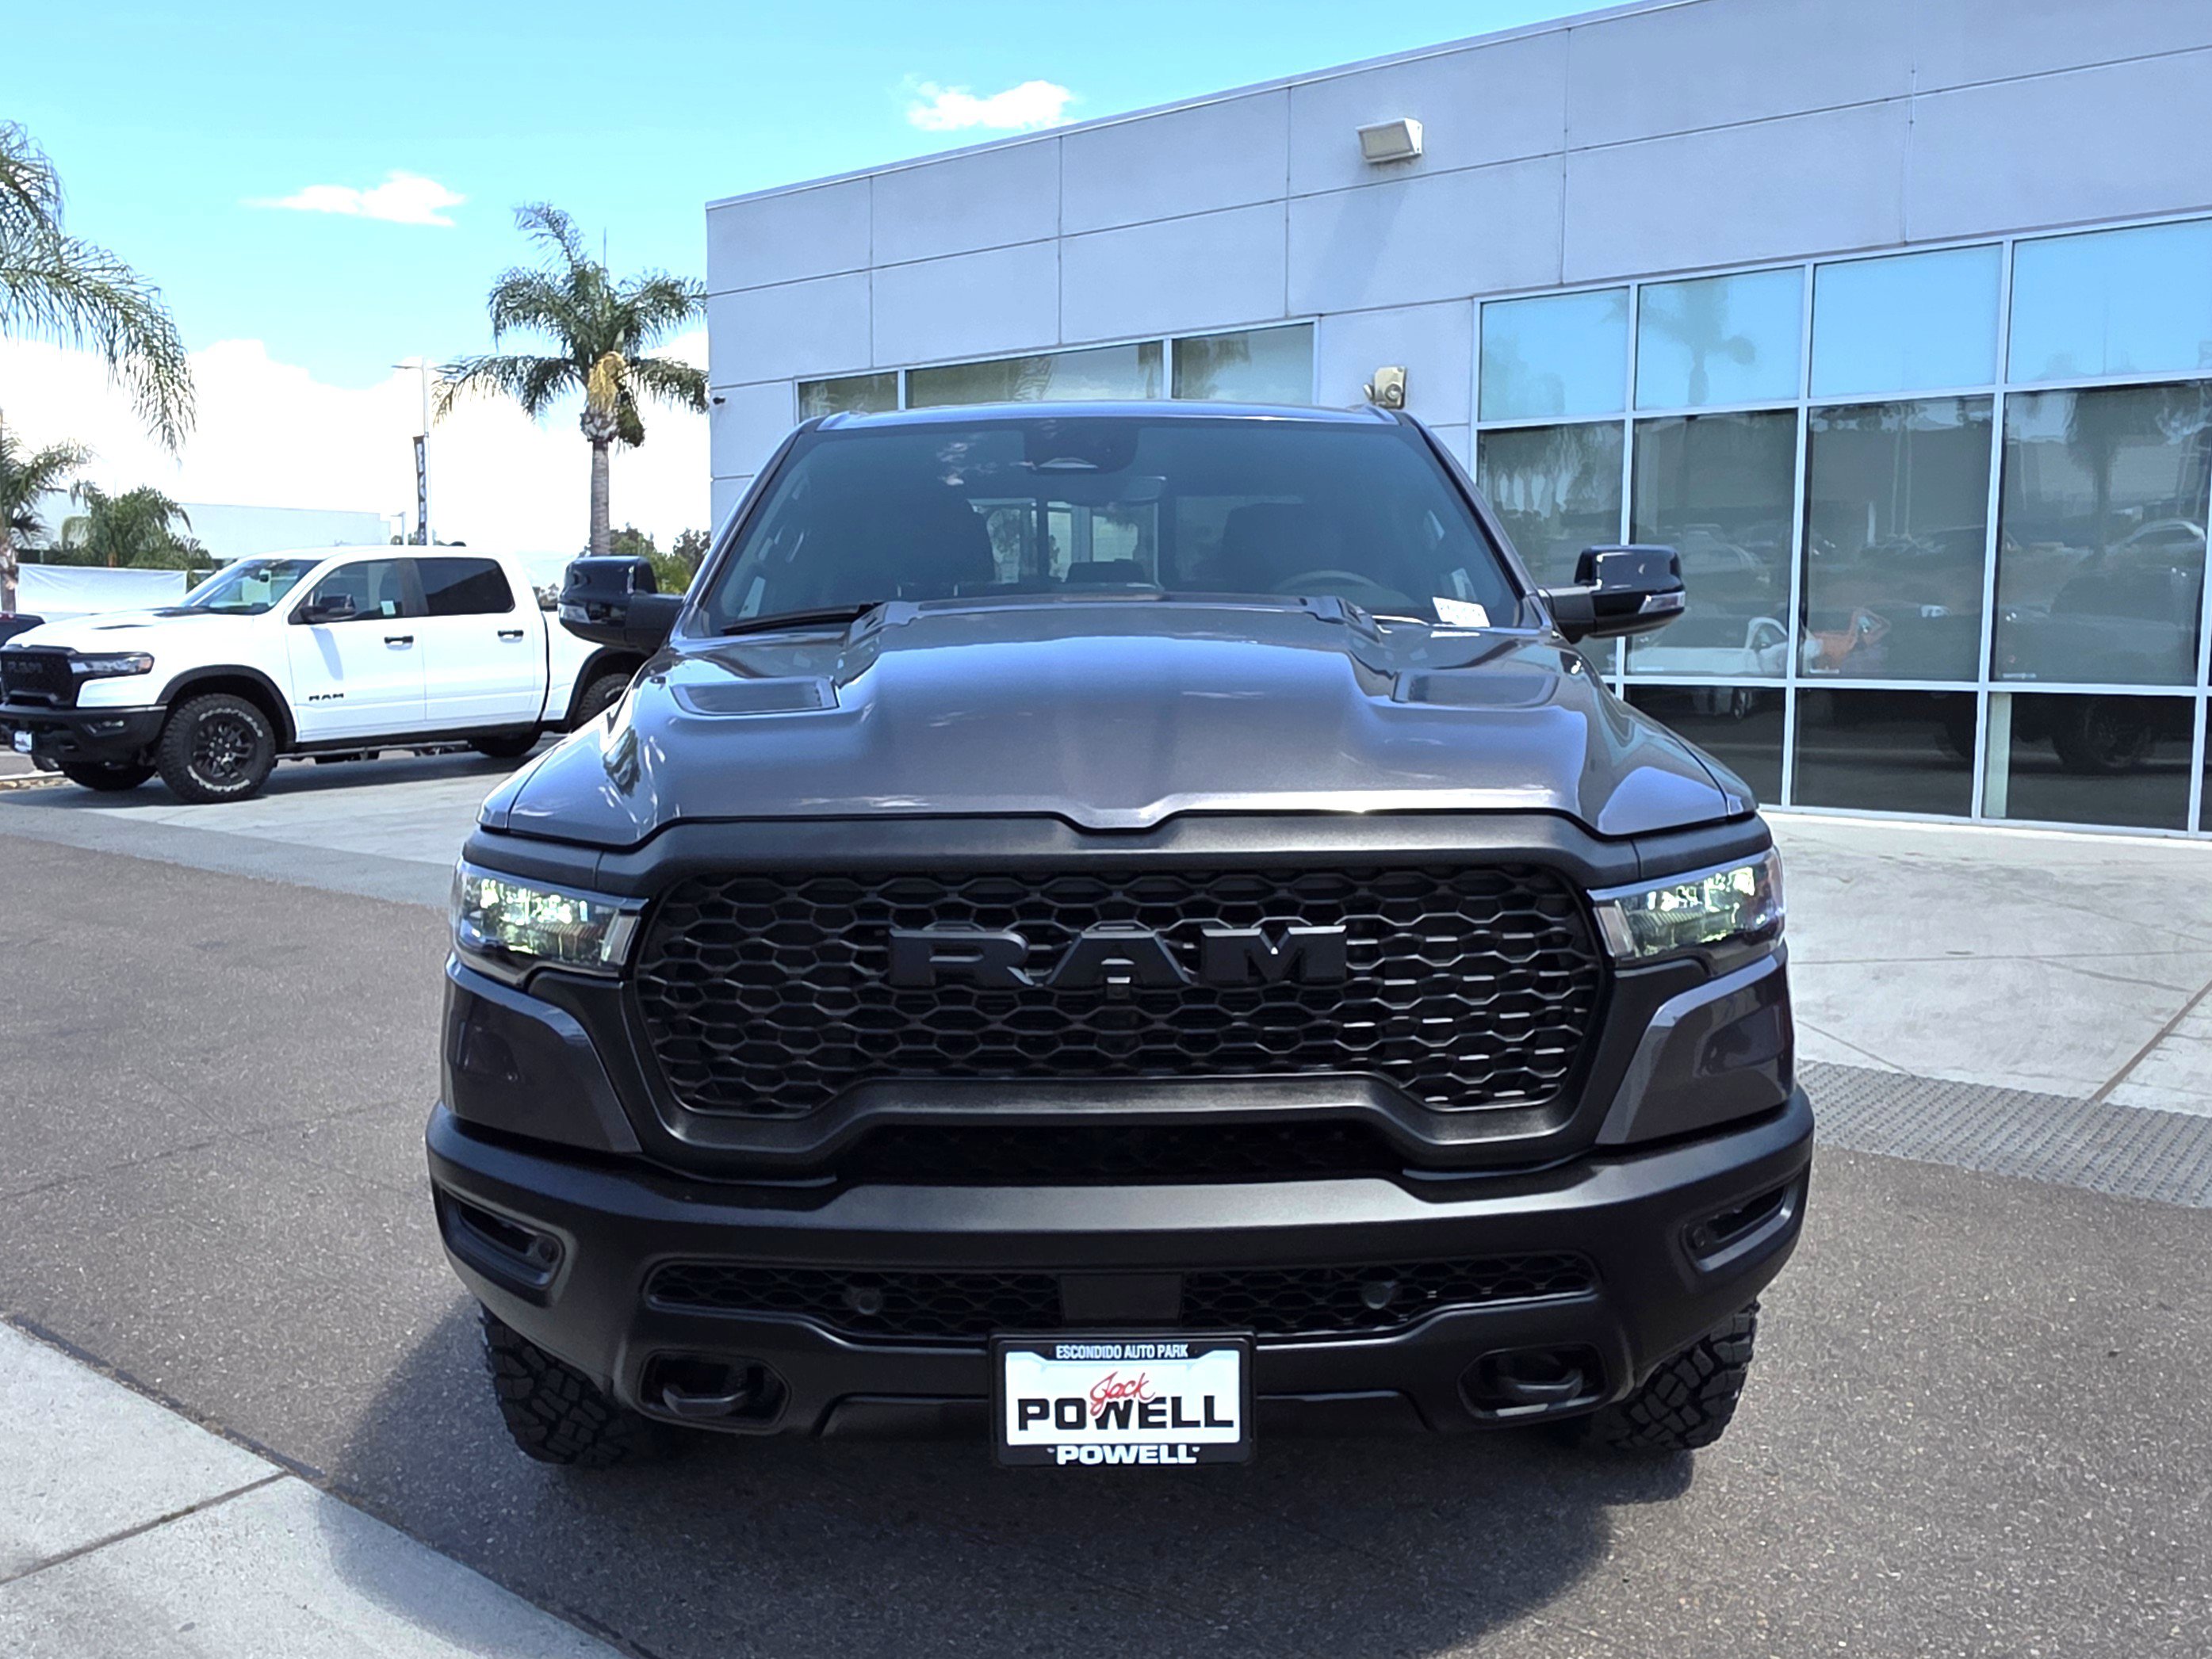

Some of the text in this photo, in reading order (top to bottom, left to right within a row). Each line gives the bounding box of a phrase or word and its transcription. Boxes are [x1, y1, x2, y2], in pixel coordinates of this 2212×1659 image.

[308, 693, 344, 701] RAM
[889, 925, 1346, 987] RAM
[1055, 1344, 1188, 1359] ESCONDIDO AUTO PARK
[1089, 1370, 1156, 1416] Jack
[1018, 1395, 1234, 1432] POWELL
[1056, 1444, 1197, 1465] POWELL
